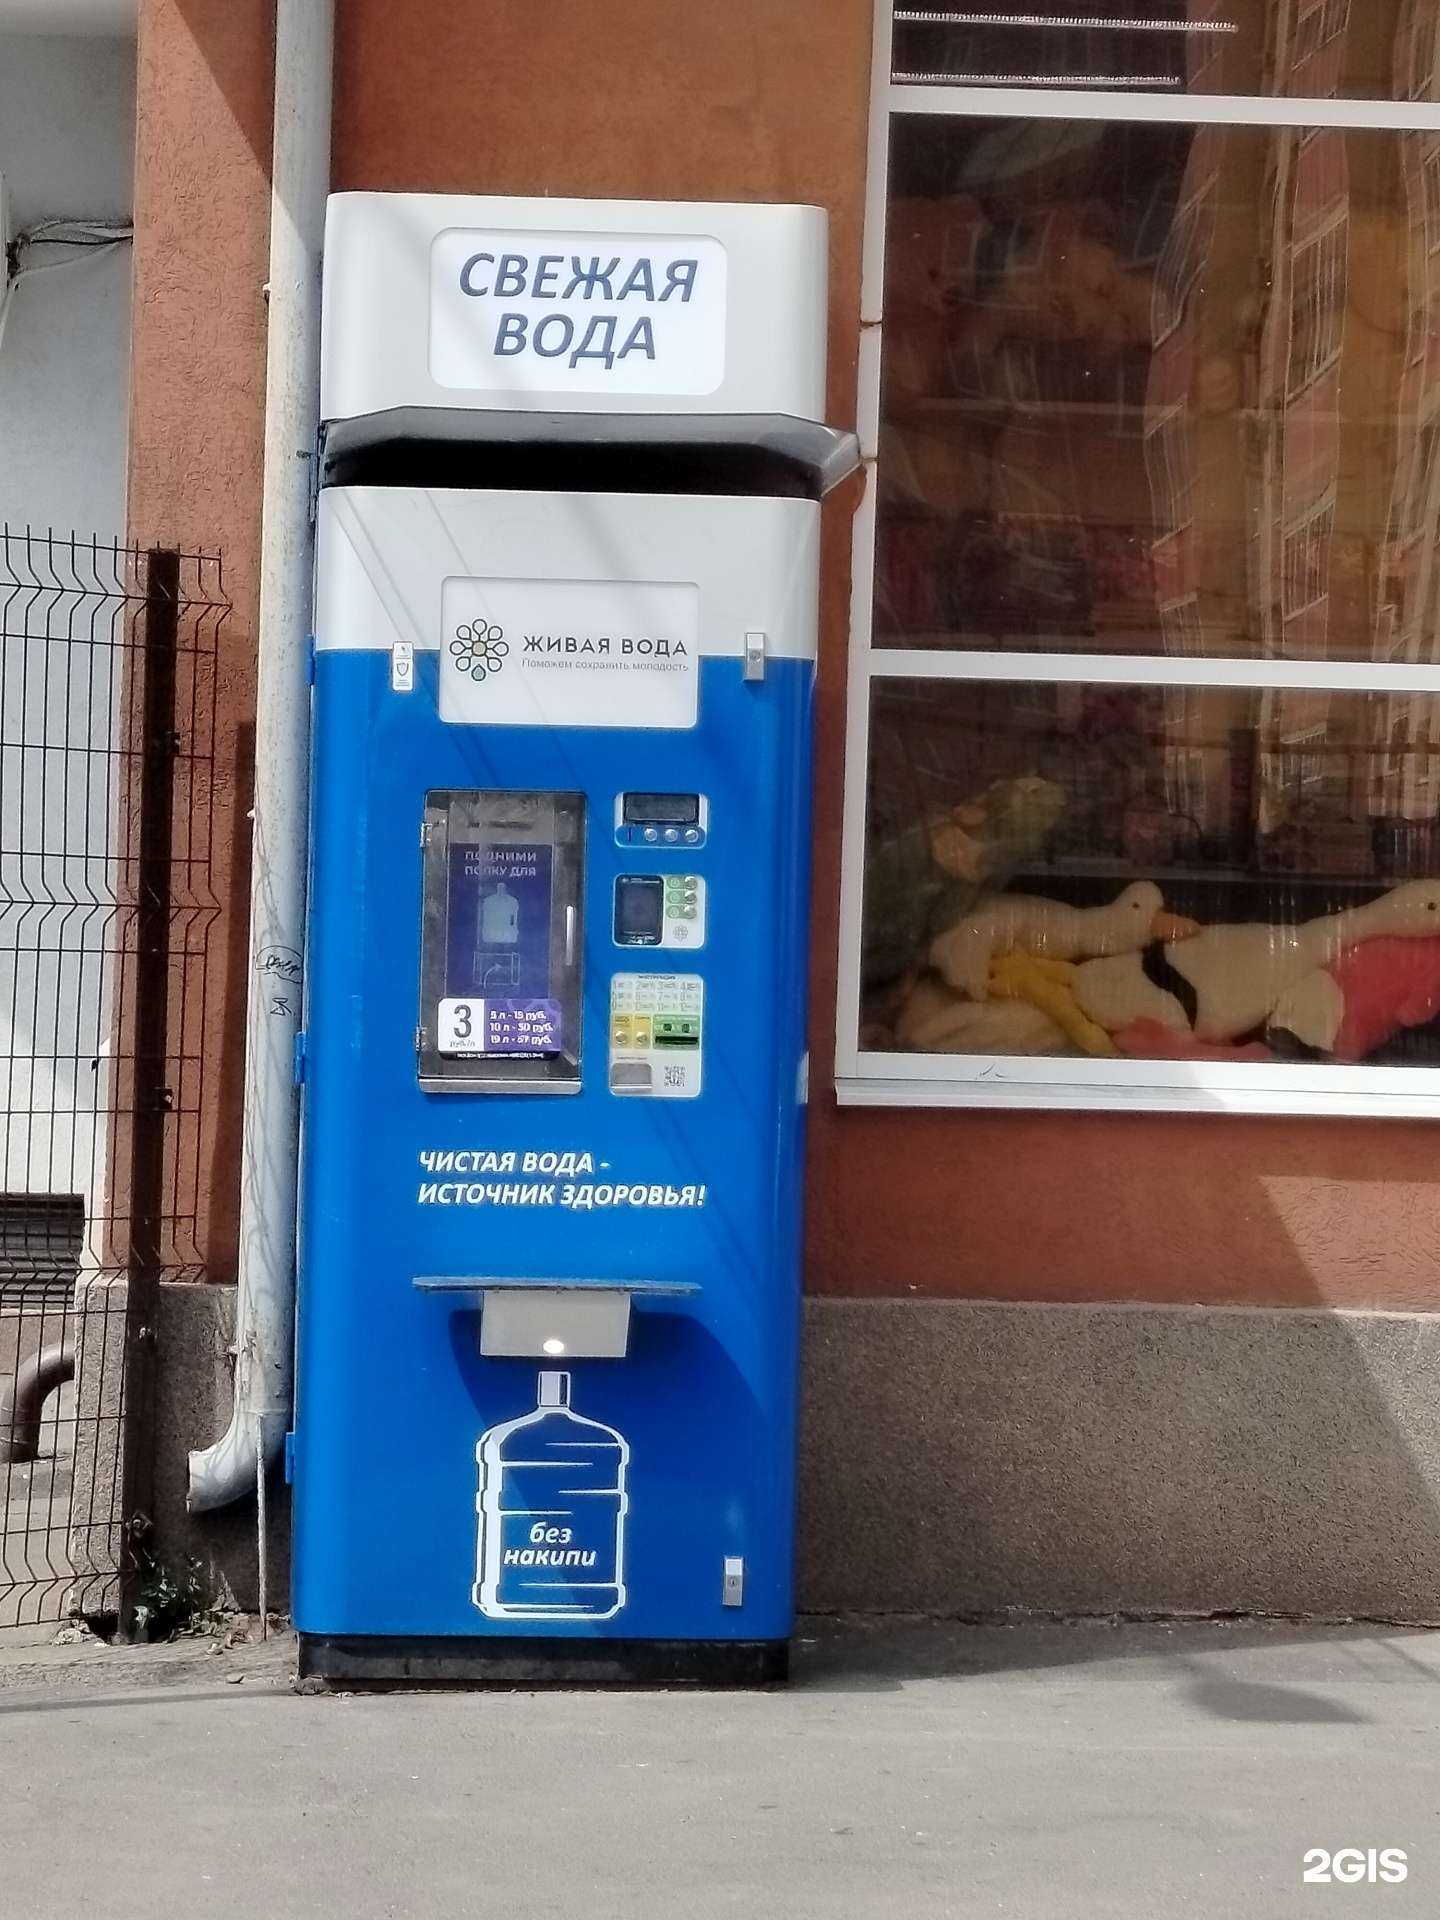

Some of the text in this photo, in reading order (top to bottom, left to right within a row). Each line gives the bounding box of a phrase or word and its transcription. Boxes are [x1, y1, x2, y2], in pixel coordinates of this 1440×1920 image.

[459, 252, 698, 302] СВЕЖАЯ
[493, 312, 656, 369] ВОДА
[523, 635, 688, 657] ЖИВАЯ ВОДА
[522, 658, 689, 672] Поможем сохранить молодость
[453, 1004, 472, 1038] 3
[490, 1022, 500, 1031] 10
[418, 1151, 516, 1173] ЧИСТАЯ
[522, 1152, 593, 1177] ВОДА
[417, 1183, 706, 1209] ИСТОЧНИК ЗДОРОВЬЯ!
[529, 1521, 572, 1544] без
[503, 1548, 597, 1567] накипи
